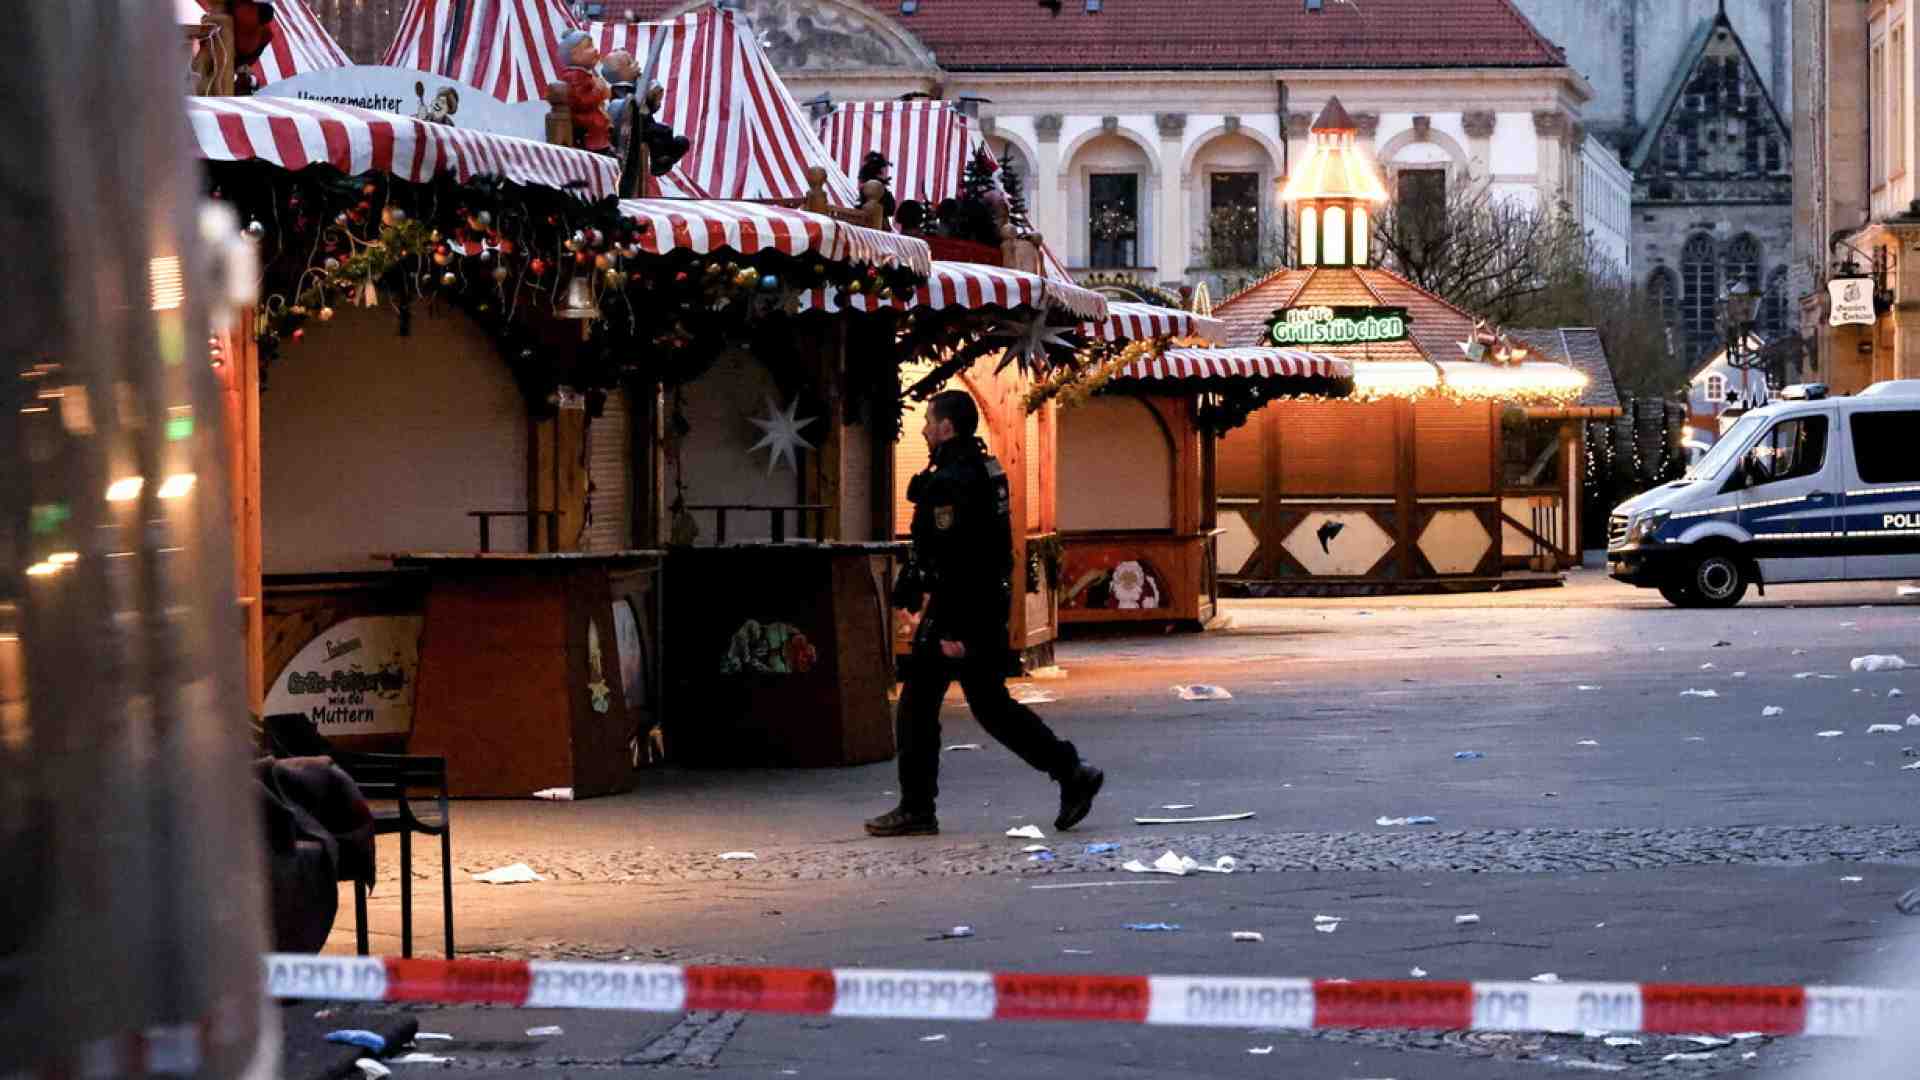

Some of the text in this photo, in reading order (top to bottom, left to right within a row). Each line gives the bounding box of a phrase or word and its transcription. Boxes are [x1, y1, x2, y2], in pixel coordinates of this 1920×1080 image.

[1273, 315, 1404, 342] Grillstübchen
[328, 692, 345, 706] wie
[311, 705, 375, 725] Muttern
